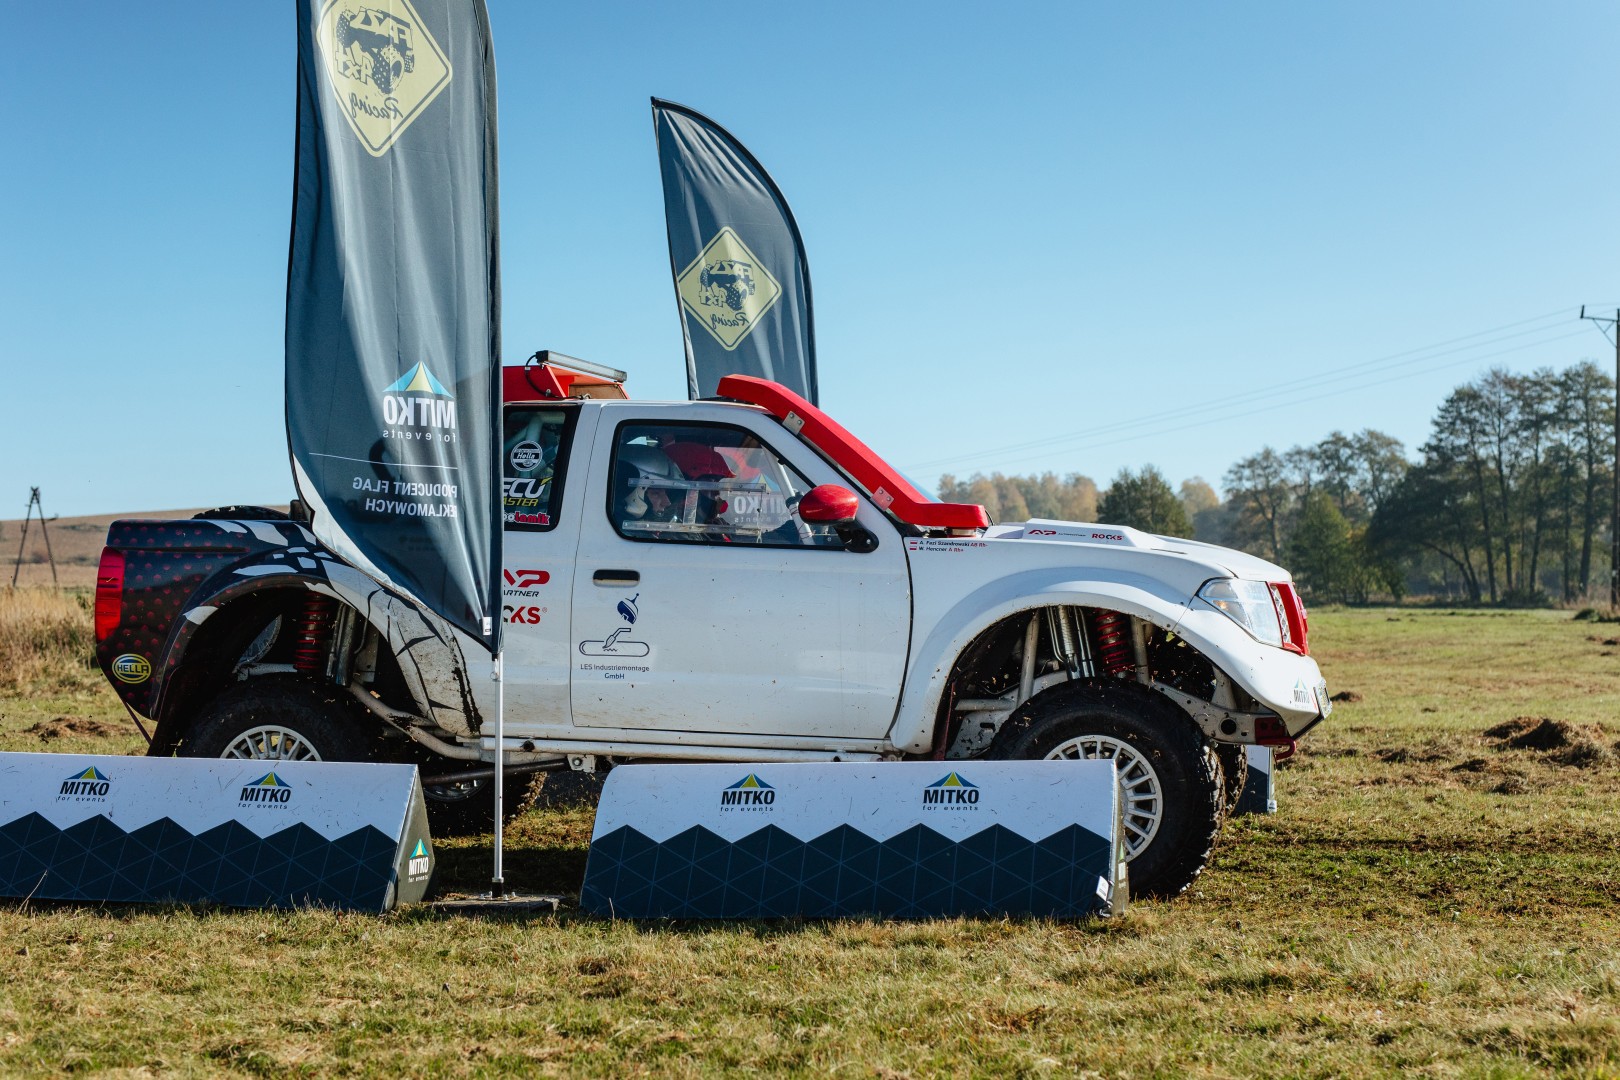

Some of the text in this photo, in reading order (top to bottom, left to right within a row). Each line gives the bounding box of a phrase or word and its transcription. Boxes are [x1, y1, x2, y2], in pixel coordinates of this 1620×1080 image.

[504, 477, 552, 498] ECU
[1091, 533, 1123, 541] ROCKS
[117, 664, 149, 674] HELLA
[580, 663, 650, 672] LES Industriemontage
[60, 781, 110, 796] MITKO
[240, 787, 292, 803] MITKO
[721, 790, 776, 805] MITKO
[923, 789, 980, 804] MITKO
[408, 857, 429, 876] MITKO
